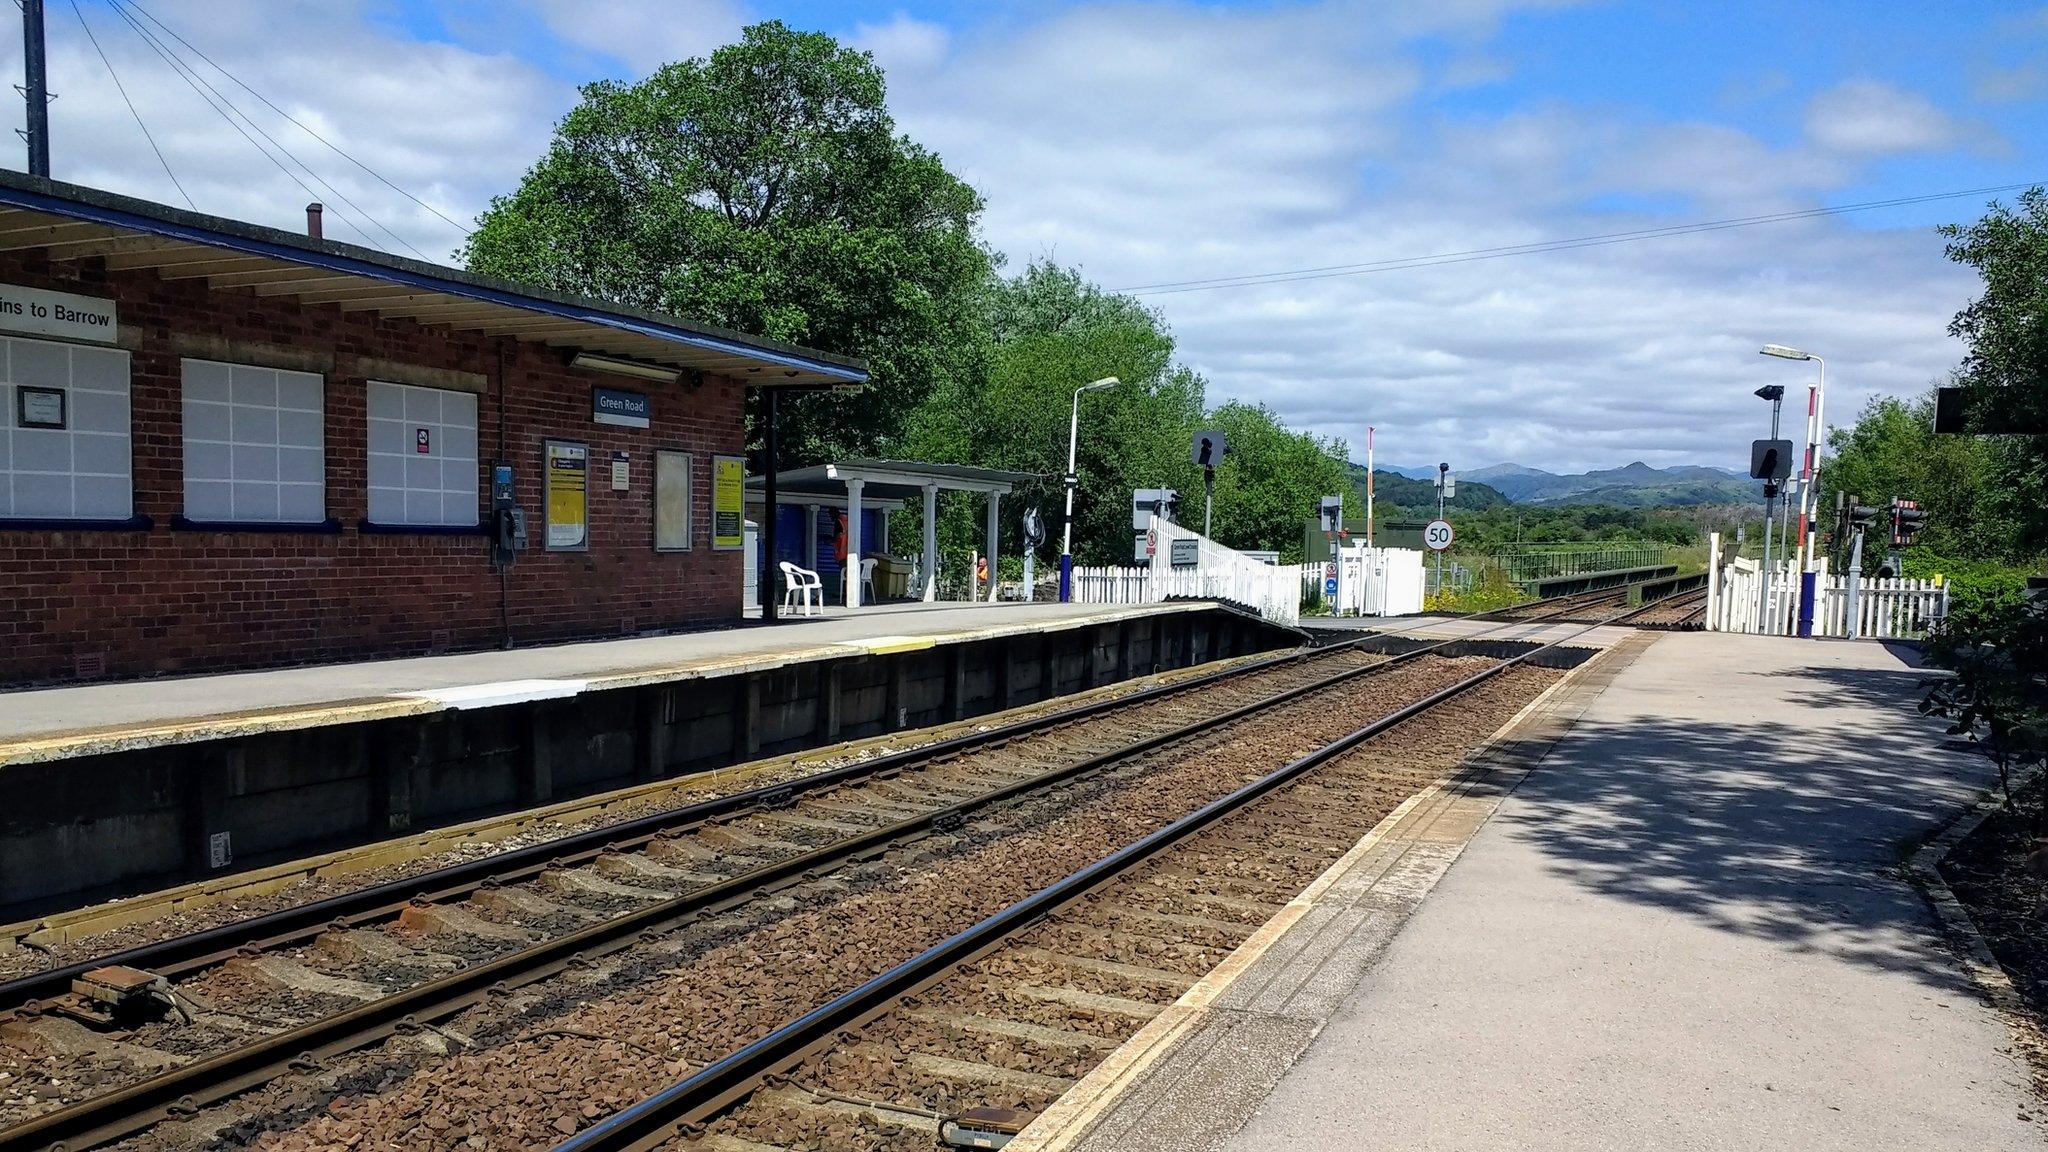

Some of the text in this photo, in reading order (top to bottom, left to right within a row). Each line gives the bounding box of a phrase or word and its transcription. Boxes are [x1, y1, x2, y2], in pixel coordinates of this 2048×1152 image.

[30, 302, 47, 318] to
[54, 304, 110, 327] Barrow
[600, 395, 644, 412] Green Road
[1429, 528, 1449, 543] 50
